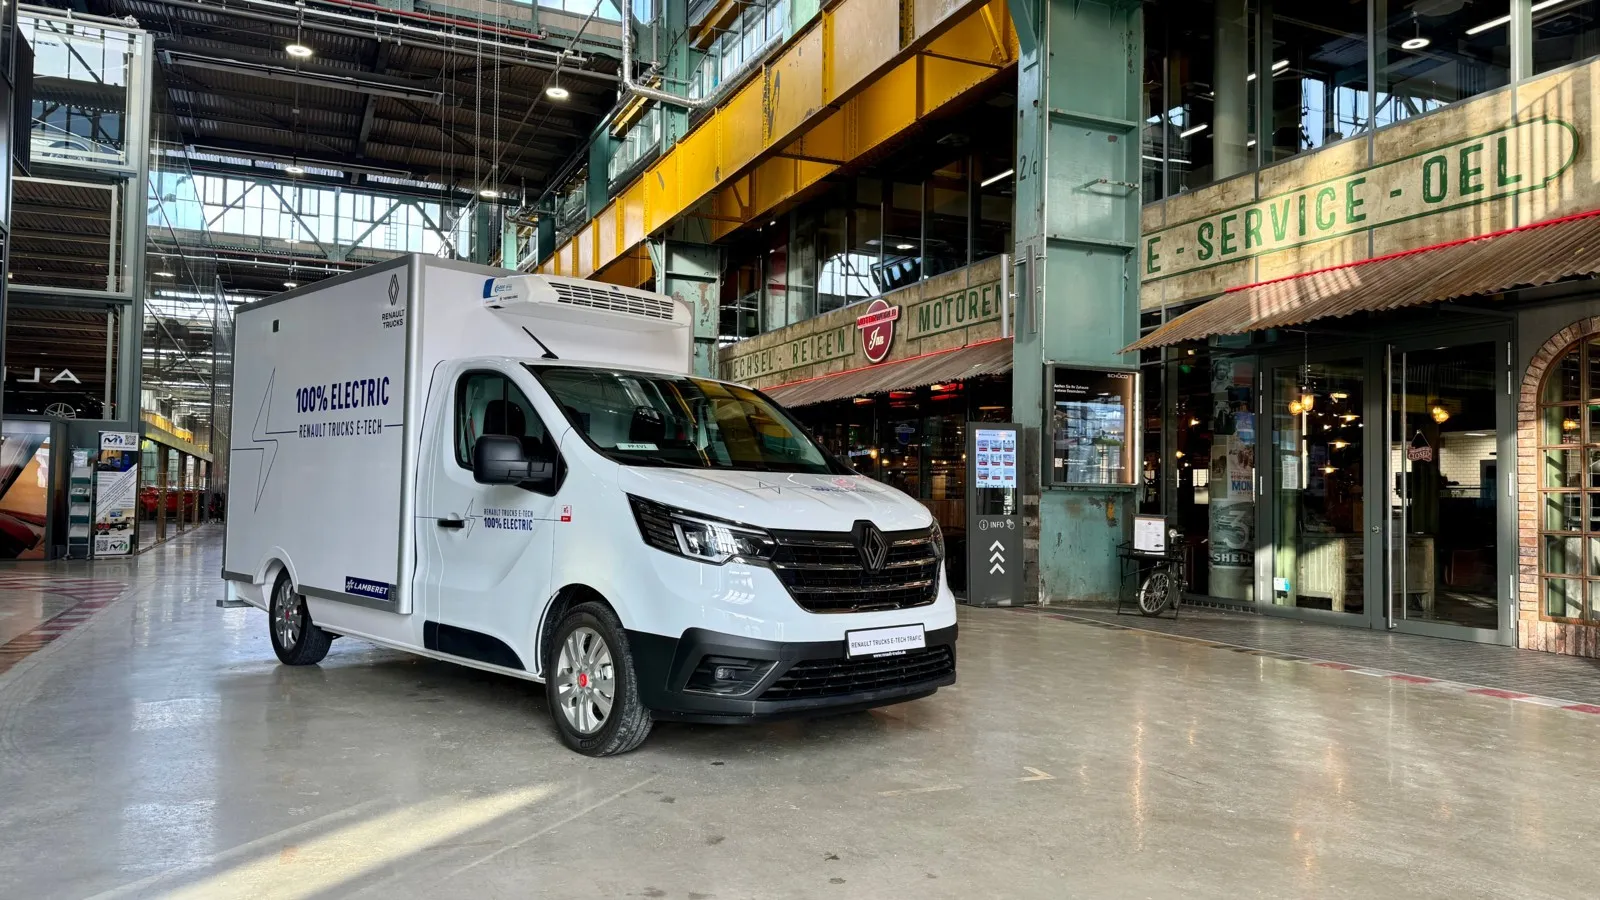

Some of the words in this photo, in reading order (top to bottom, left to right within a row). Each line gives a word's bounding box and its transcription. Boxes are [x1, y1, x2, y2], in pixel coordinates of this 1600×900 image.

[1147, 236, 1161, 274] E
[1197, 176, 1366, 261] SERVICE
[1423, 135, 1522, 204] OEL
[382, 309, 405, 321] RENAULT
[382, 318, 404, 328] TRUCKS
[792, 329, 845, 365] REIFEN
[296, 385, 328, 413] 100%
[330, 376, 390, 410] ELECTRIC
[299, 423, 326, 438] RENAULT
[328, 420, 354, 437] TRUCKS
[356, 419, 382, 435] E-TECH
[484, 508, 501, 516] RENAULT
[501, 508, 518, 517] TRUCKS
[483, 517, 502, 529] 100%
[503, 518, 533, 531] ELECTRIC
[990, 521, 1005, 529] INFO
[353, 582, 389, 595] LAMBERET
[851, 640, 872, 648] RENAULT
[872, 638, 890, 646] TRUCKS
[890, 636, 907, 644] E-TECH
[906, 634, 922, 642] TRAFIC
